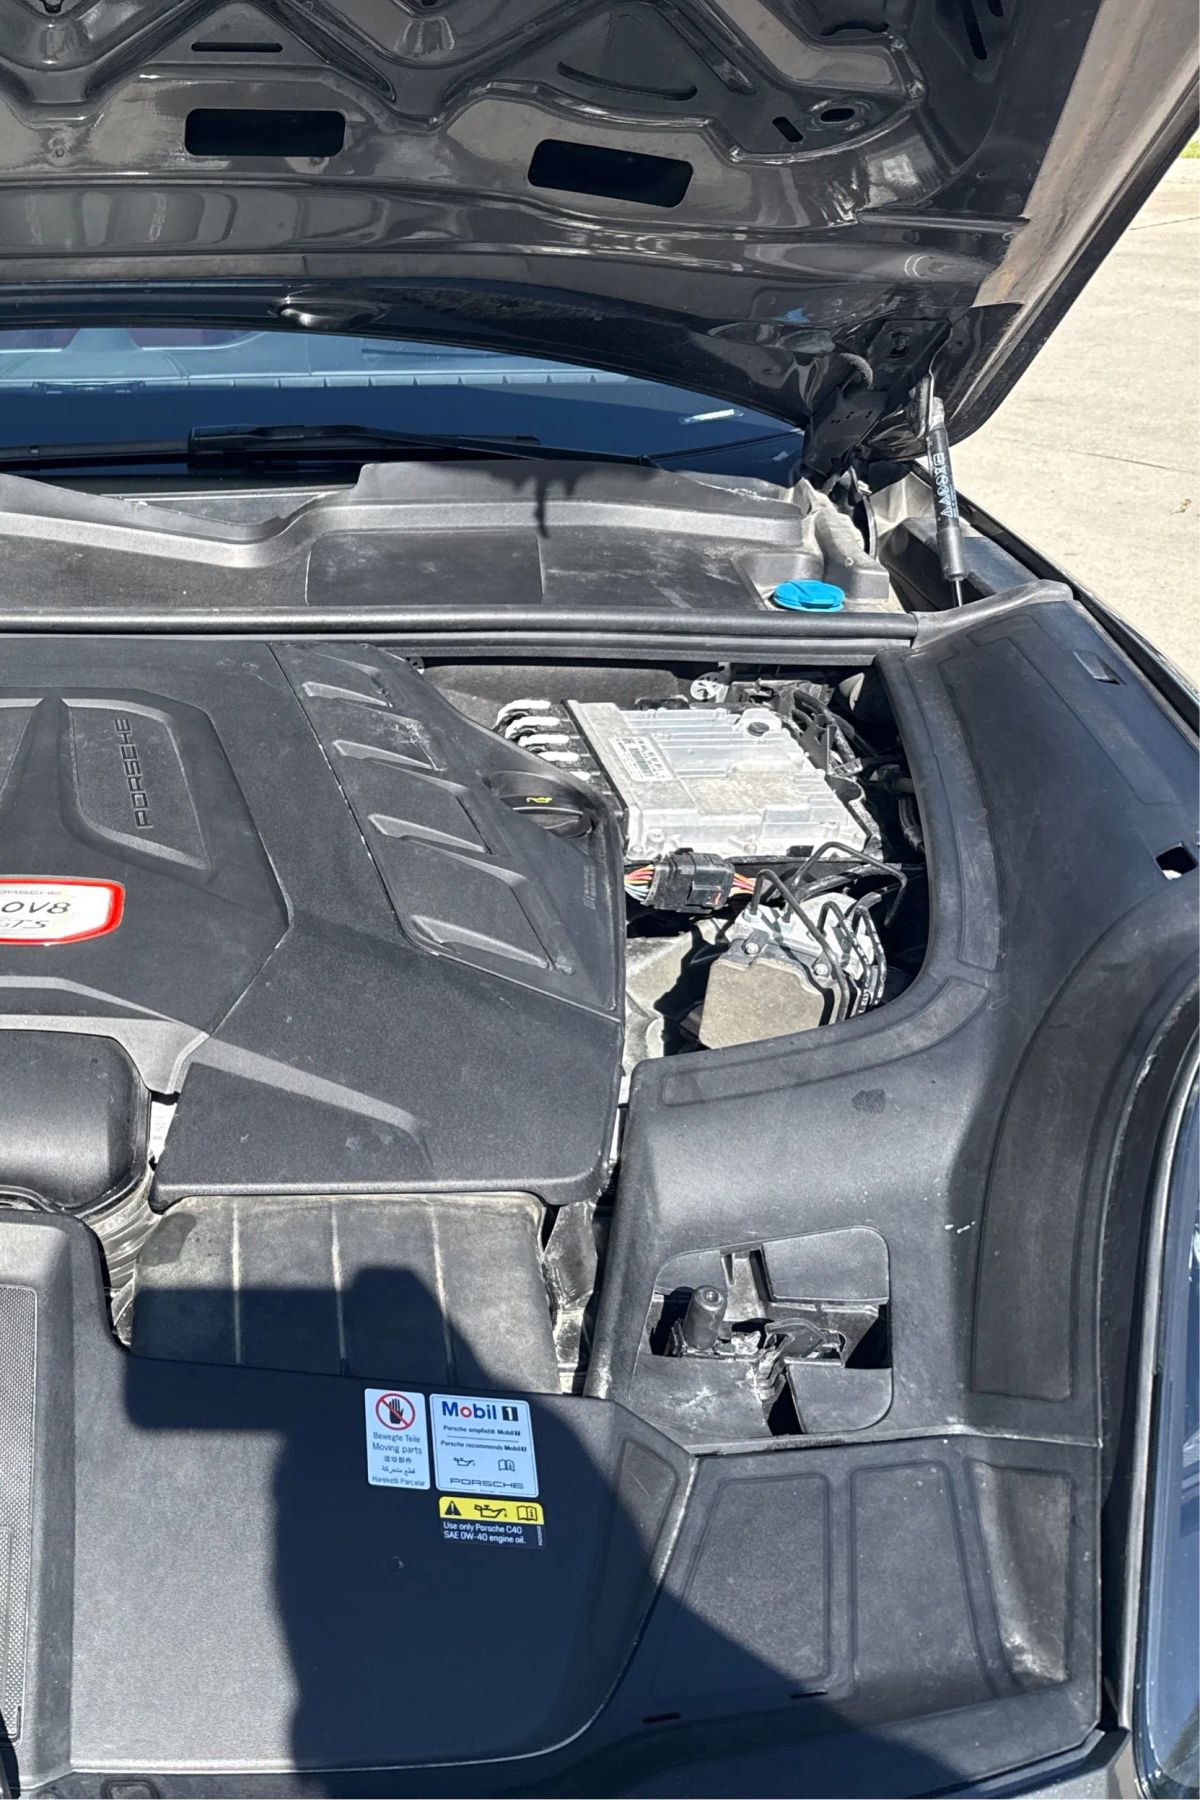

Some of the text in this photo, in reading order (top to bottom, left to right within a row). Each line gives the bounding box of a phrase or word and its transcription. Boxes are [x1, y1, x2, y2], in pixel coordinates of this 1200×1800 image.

[114, 719, 153, 827] PORSCHE
[442, 1401, 518, 1422] Mobil 1
[443, 1425, 467, 1433] Porsche
[373, 1432, 421, 1443] Bewegte Teile
[372, 1442, 422, 1455] Moving parts
[441, 1440, 465, 1448] Porsche
[466, 1443, 503, 1451] recommends
[450, 1478, 524, 1489] PORSCHE
[443, 1521, 522, 1534] Use only Porsche C40
[444, 1531, 527, 1544] SAE 0W-40 engine oil.
